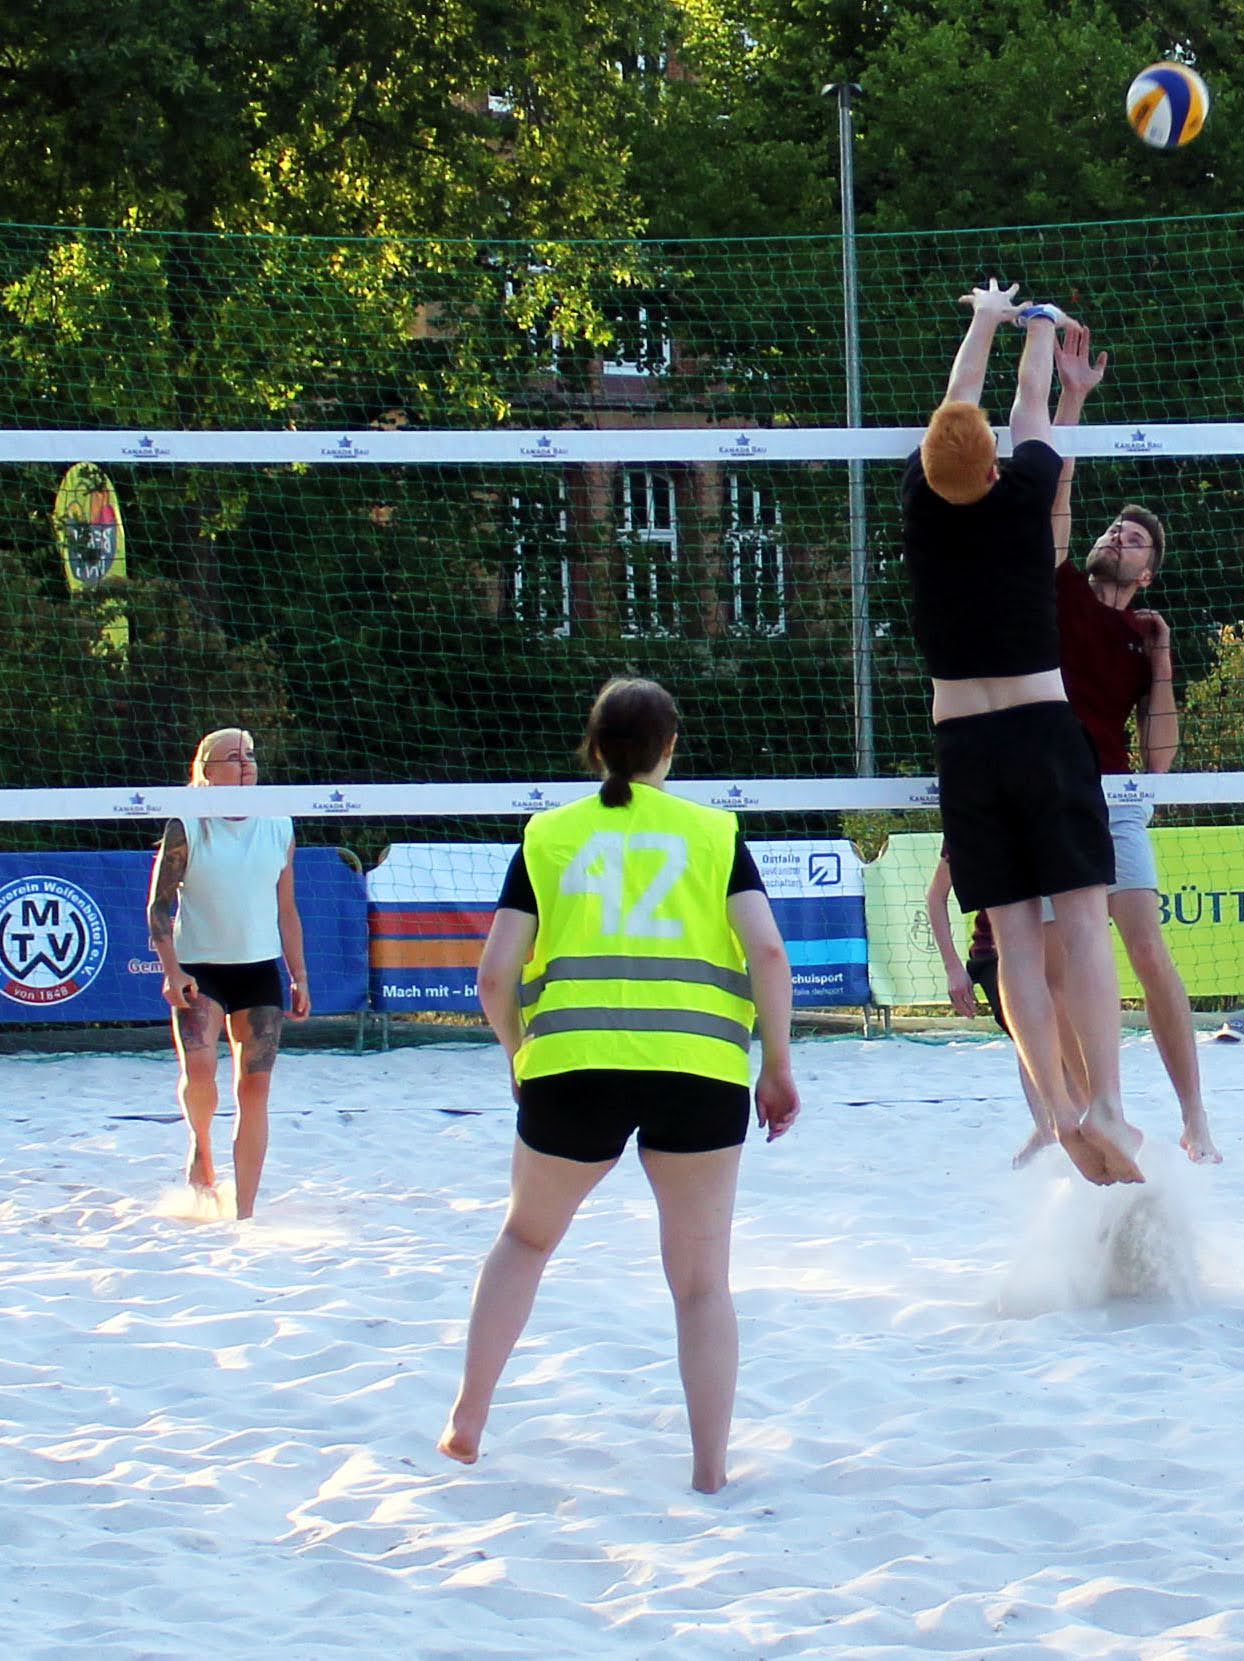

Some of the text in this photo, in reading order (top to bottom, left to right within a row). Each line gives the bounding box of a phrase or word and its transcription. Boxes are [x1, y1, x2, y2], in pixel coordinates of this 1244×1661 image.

[560, 831, 688, 938] 42
[128, 958, 165, 973] Gem
[791, 972, 844, 986] chulsport
[382, 985, 421, 998] Mach
[424, 984, 449, 998] mit
